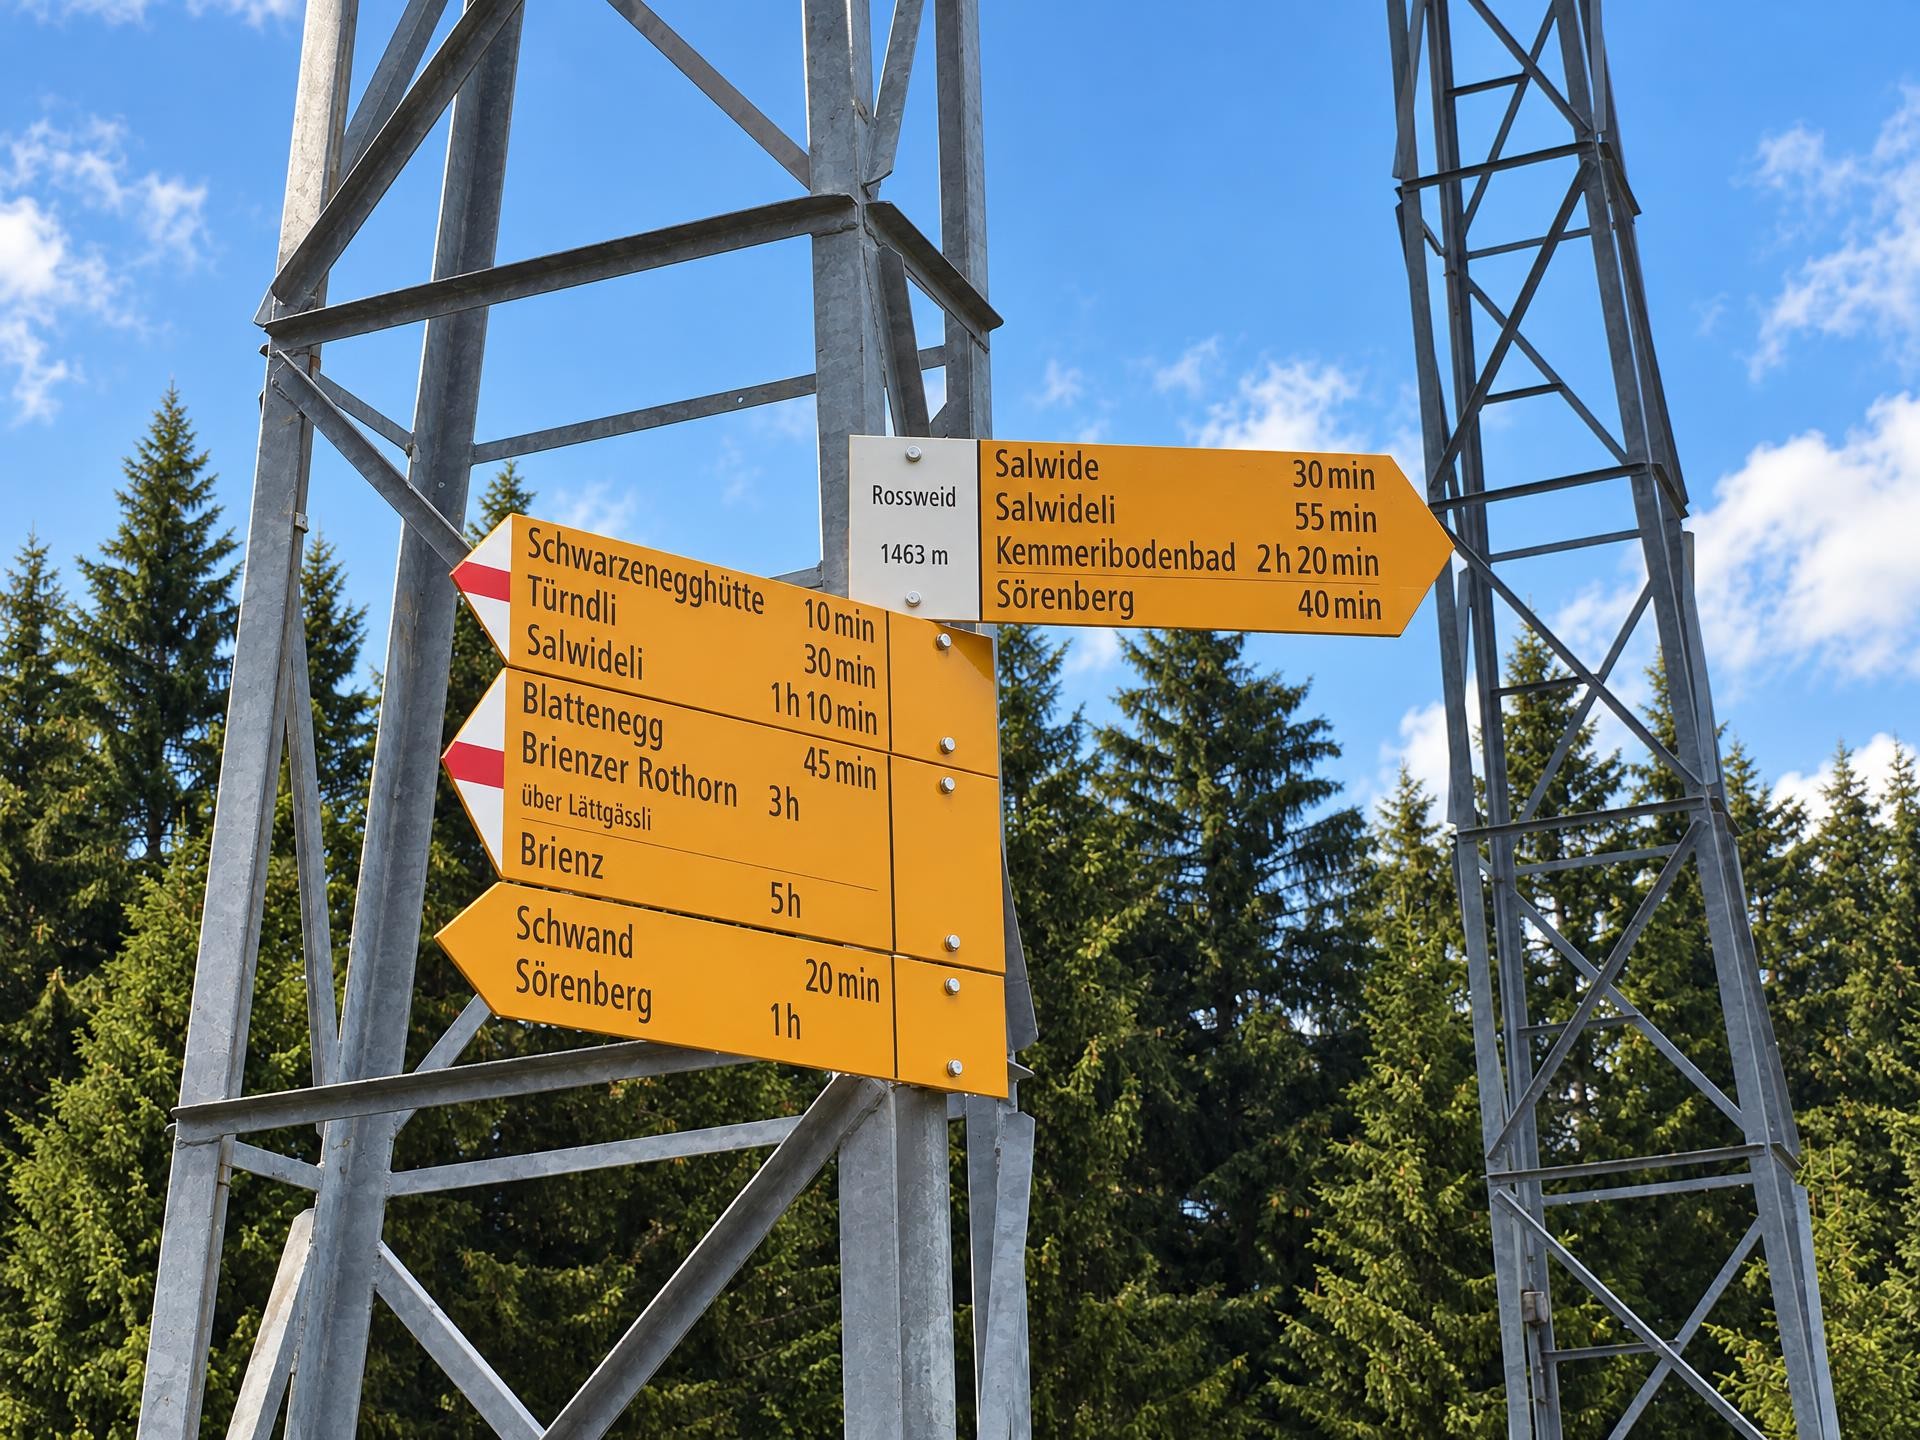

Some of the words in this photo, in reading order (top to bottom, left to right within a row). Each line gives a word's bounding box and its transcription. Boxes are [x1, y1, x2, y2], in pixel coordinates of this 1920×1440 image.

[996, 449, 1099, 481] Salwide
[872, 484, 956, 508] Rossweid
[995, 492, 1115, 524] Salwideli
[527, 526, 764, 615] Schwarzenegghütte
[881, 543, 925, 565] 1463
[931, 549, 948, 566] m
[997, 535, 1236, 572] Kemmeribodenbad
[527, 574, 616, 626] Türndli
[997, 579, 1134, 621] Sörenberg
[527, 623, 643, 680] Salwideli
[523, 681, 663, 752] Blattenegg
[522, 730, 629, 784] Brienzer
[639, 756, 737, 807] Rothorn
[521, 783, 562, 812] über
[569, 793, 652, 831] Lättgässli
[521, 831, 604, 880] Brienz
[516, 905, 633, 959] Schwand
[516, 958, 652, 1024] Sörenberg
